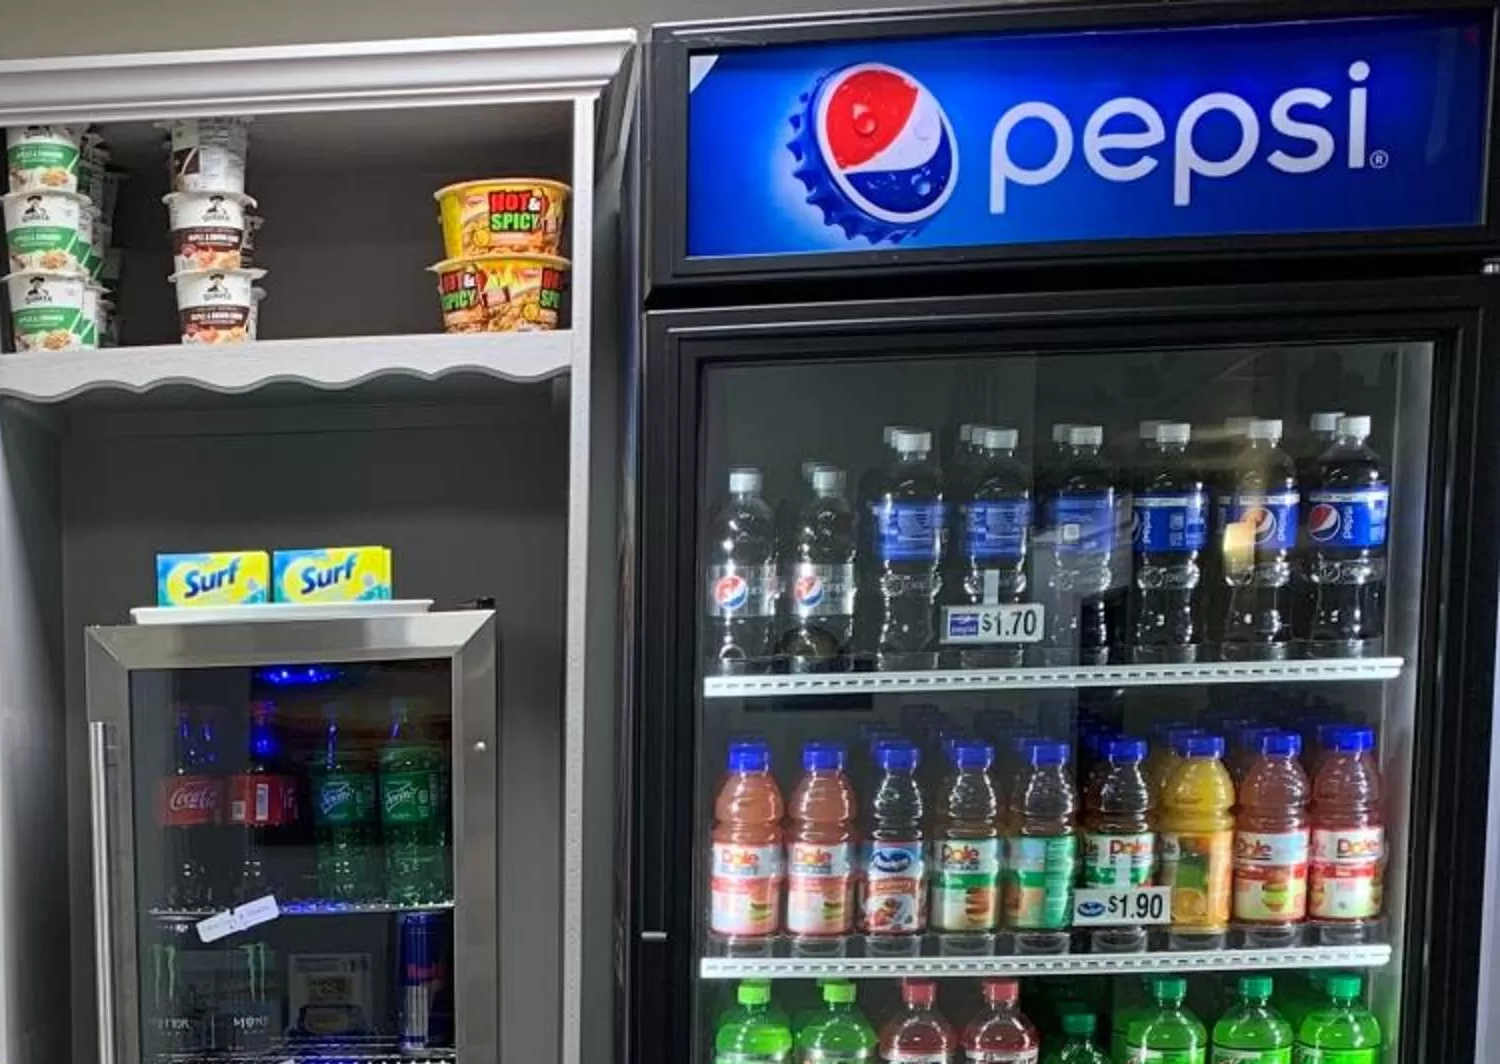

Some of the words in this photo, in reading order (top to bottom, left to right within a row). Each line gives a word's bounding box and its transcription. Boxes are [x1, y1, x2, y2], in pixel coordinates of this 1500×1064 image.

[990, 61, 1371, 215] pepsi
[491, 192, 530, 212] HOT
[491, 213, 539, 230] SPICY
[184, 560, 241, 597] Surf
[300, 555, 358, 594] Surf
[981, 610, 1037, 637] $1.70
[941, 843, 980, 864] Dole
[1107, 895, 1164, 920] $1.90
